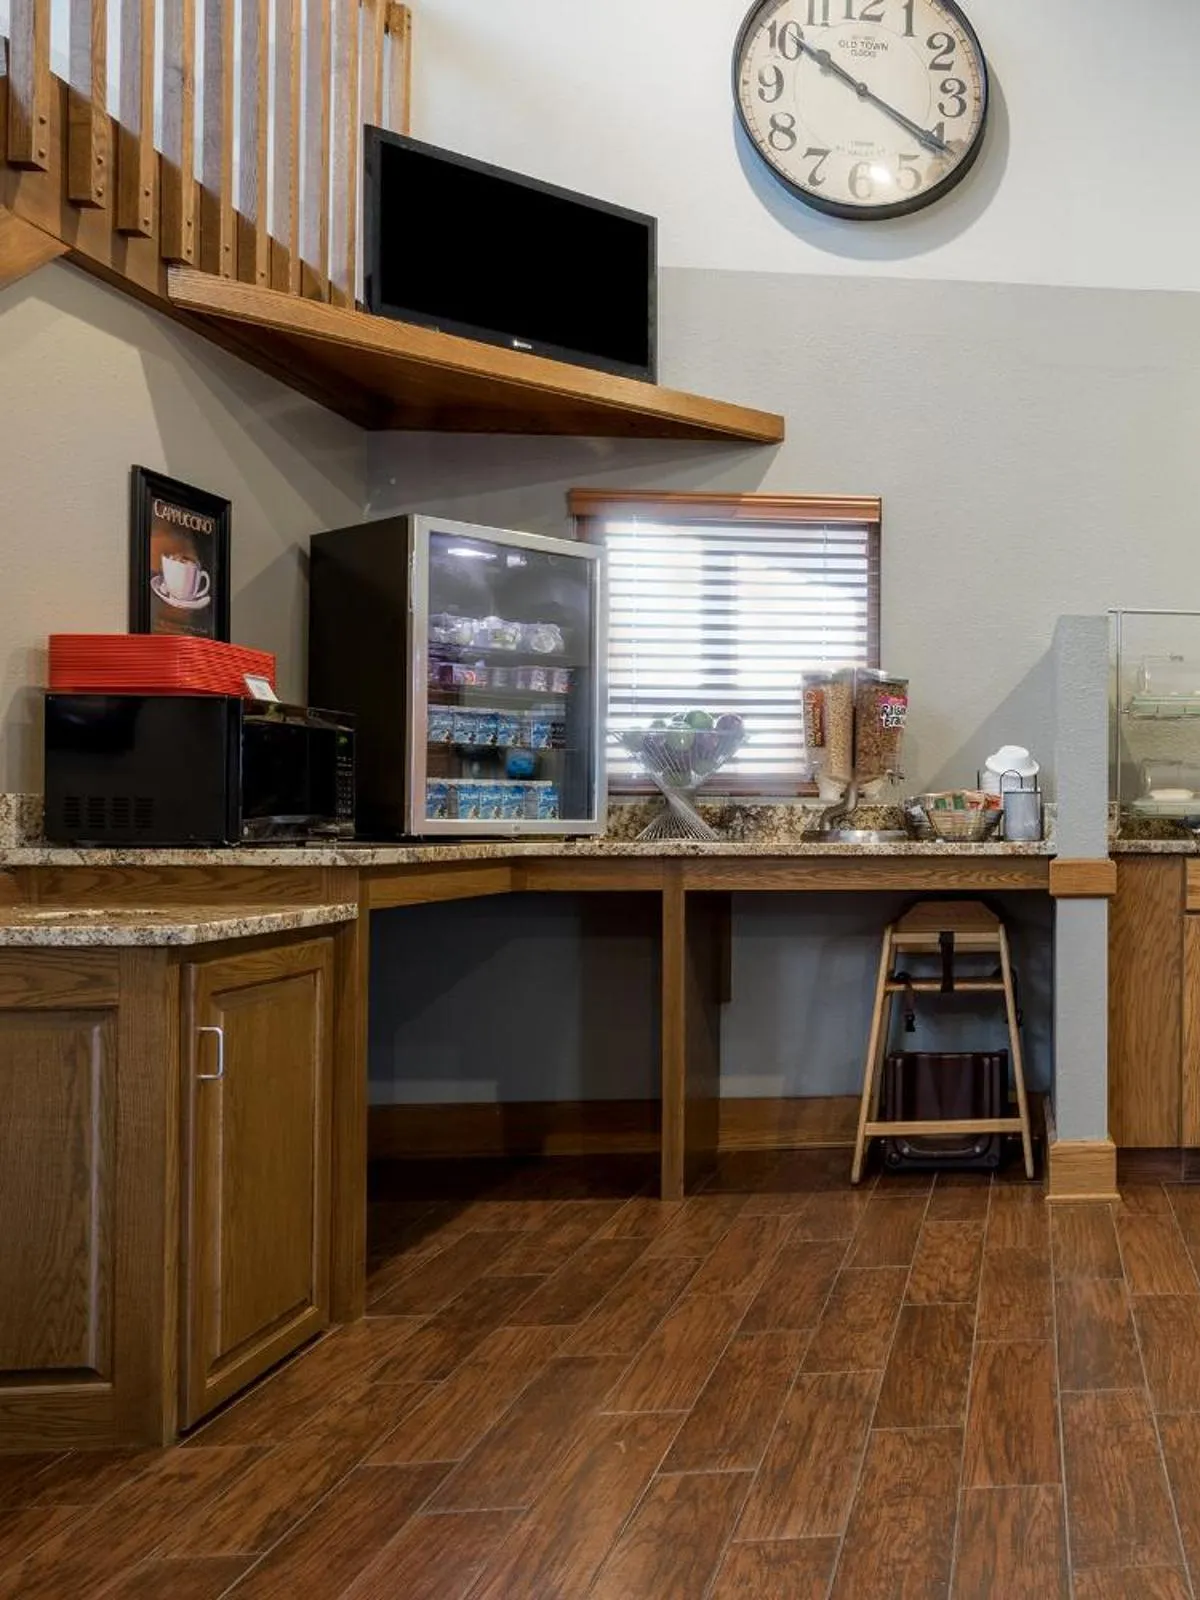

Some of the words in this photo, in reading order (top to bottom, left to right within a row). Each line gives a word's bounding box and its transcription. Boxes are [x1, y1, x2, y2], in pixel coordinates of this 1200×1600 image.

[767, 20, 804, 61] 10
[838, 39, 858, 49] OLD
[860, 41, 889, 51] TOWN
[926, 32, 956, 71] 2
[757, 65, 785, 103] 9
[937, 78, 967, 118] 3
[768, 112, 797, 151] 8
[802, 148, 832, 187] 7
[848, 161, 875, 200] 6
[897, 153, 922, 192] 5
[154, 499, 214, 535] CAPPUCCINO
